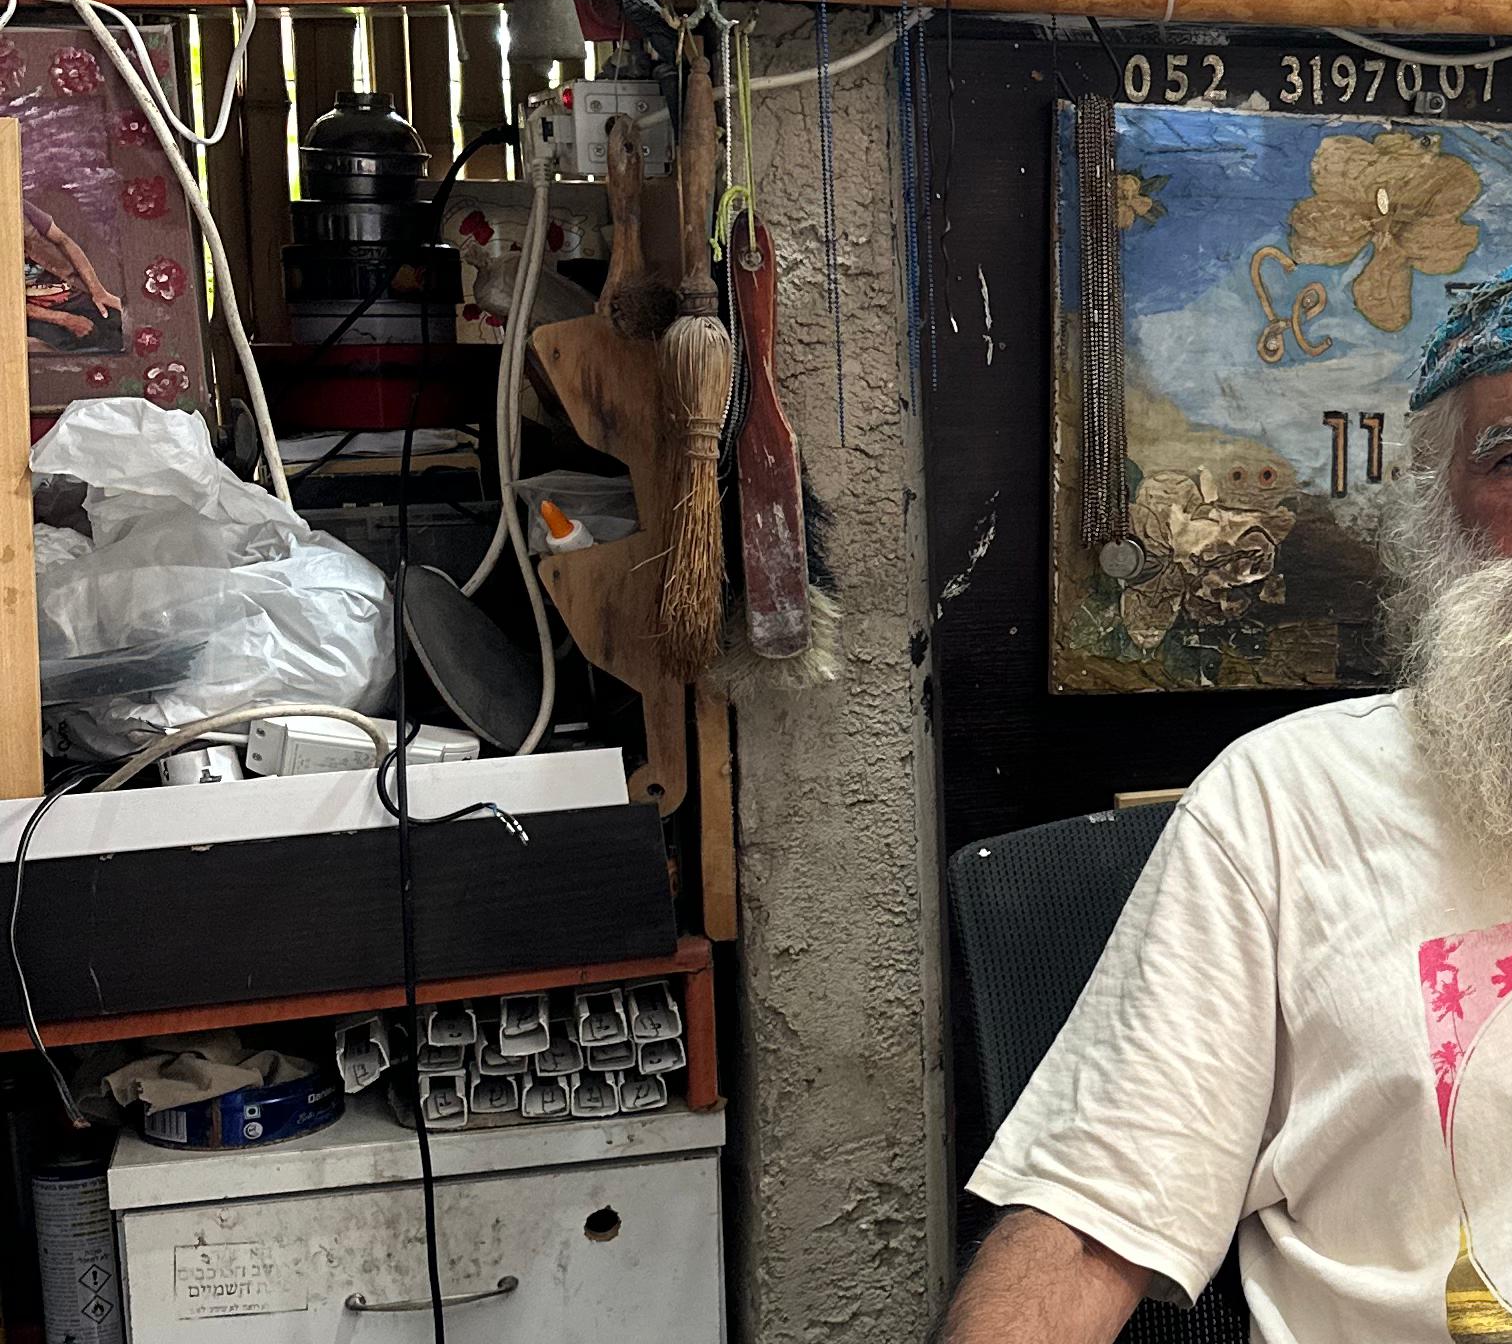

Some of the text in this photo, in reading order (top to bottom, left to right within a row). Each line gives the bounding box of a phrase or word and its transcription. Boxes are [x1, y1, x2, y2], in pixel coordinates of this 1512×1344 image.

[1124, 54, 1494, 105] 052 3197007
[189, 1282, 251, 1297] השמיים
